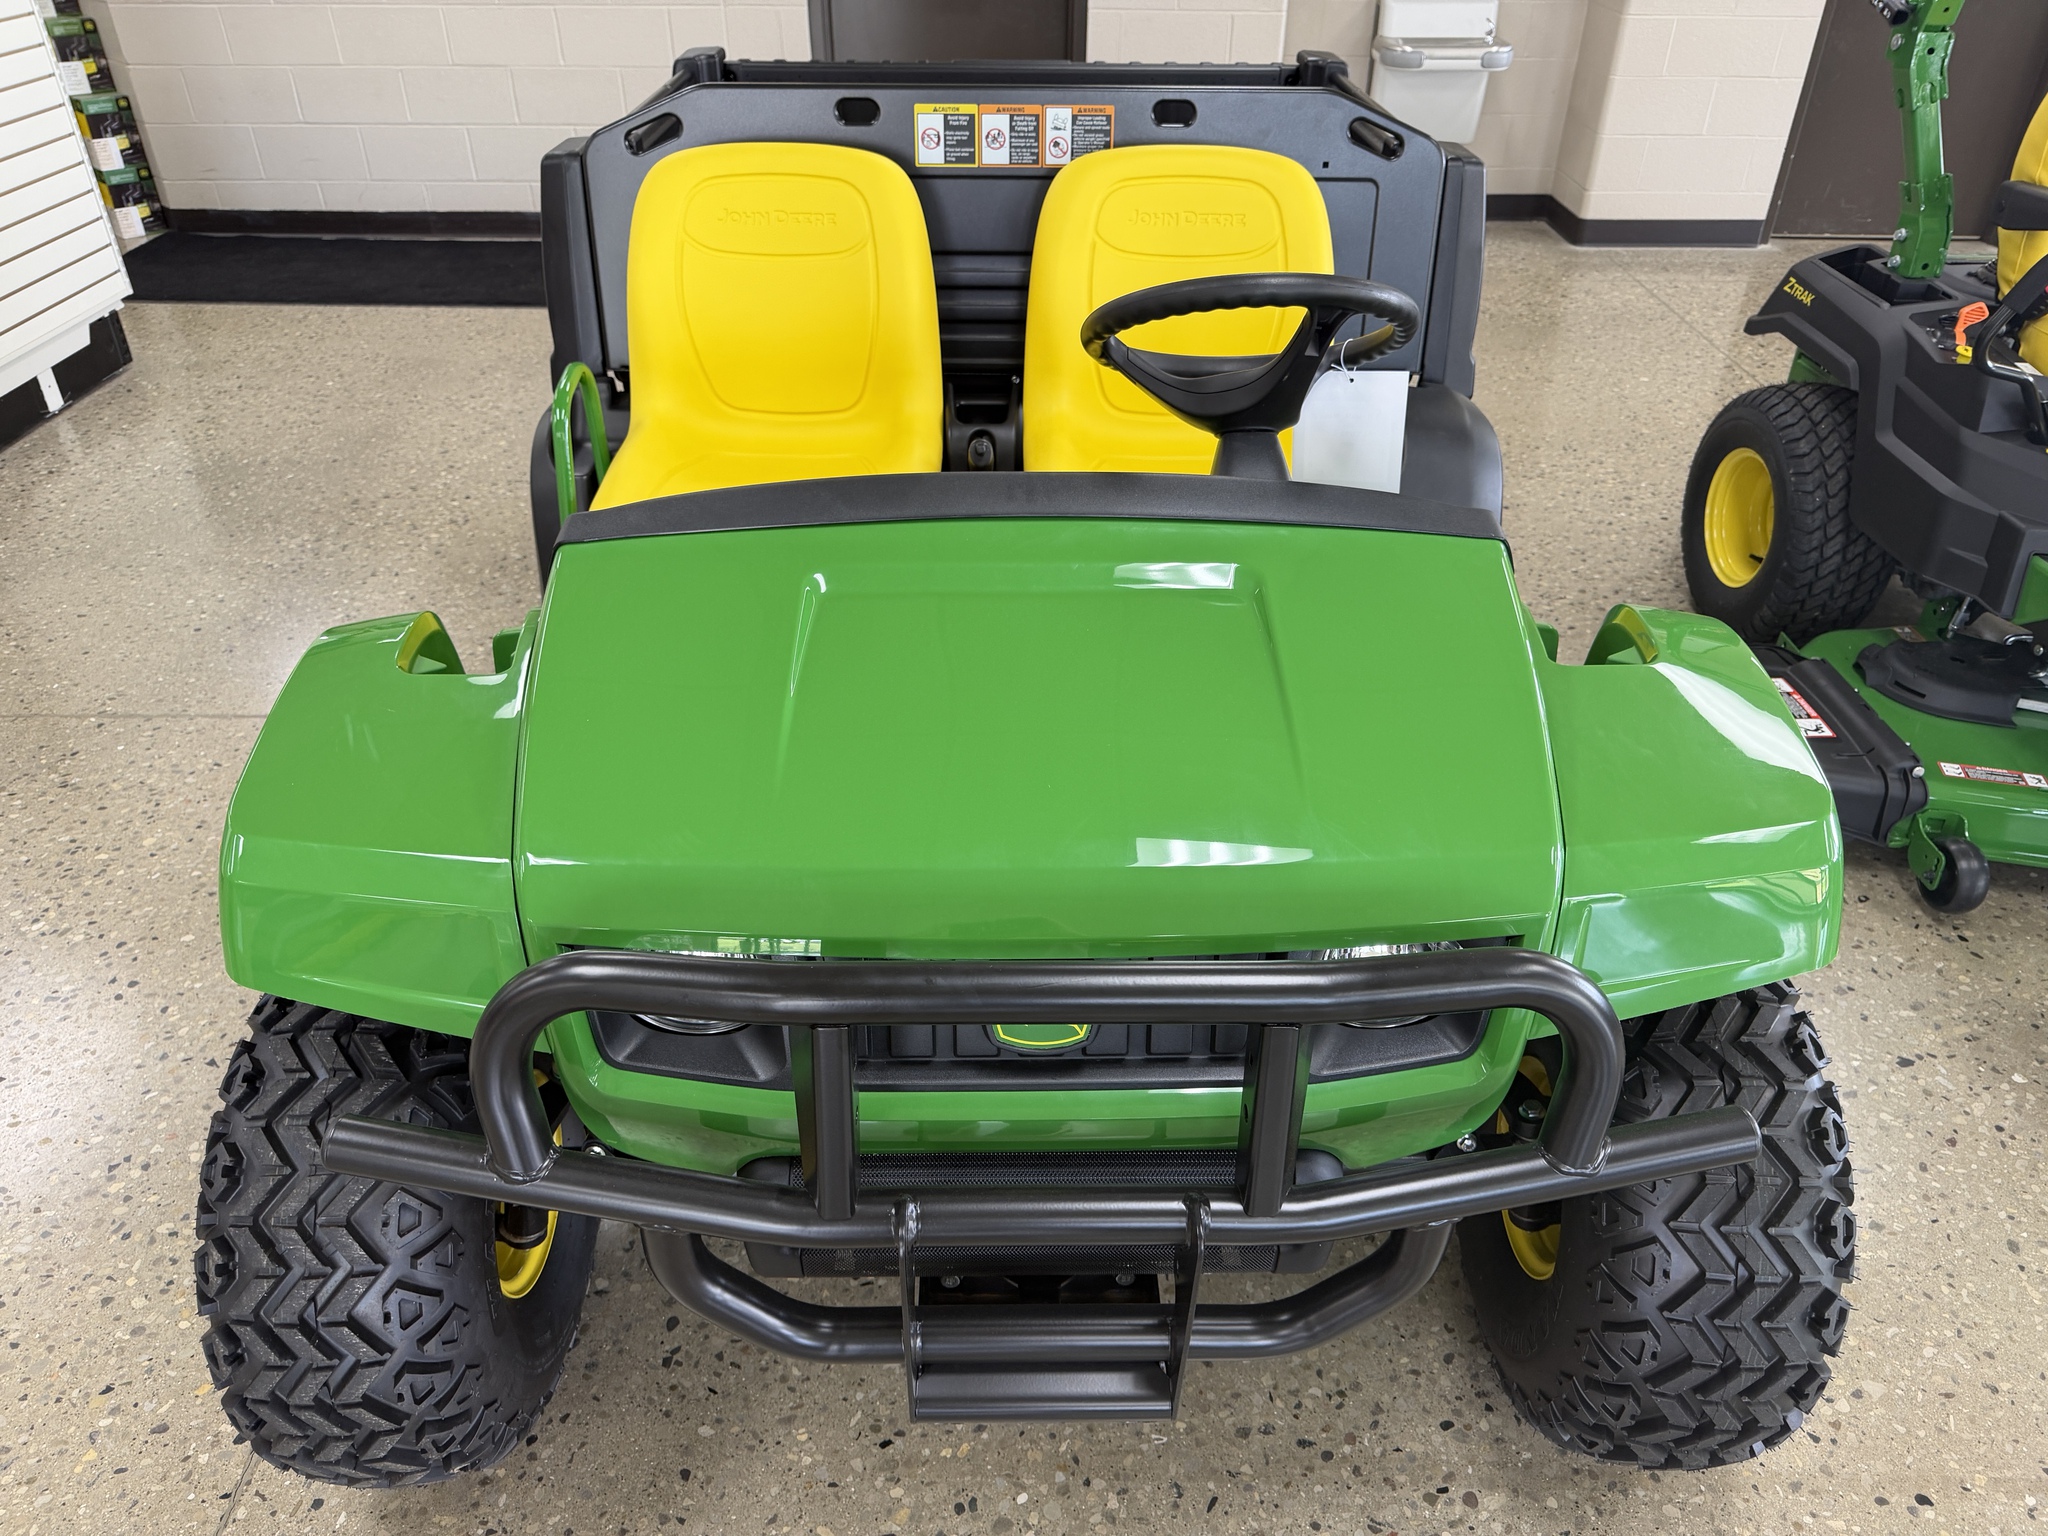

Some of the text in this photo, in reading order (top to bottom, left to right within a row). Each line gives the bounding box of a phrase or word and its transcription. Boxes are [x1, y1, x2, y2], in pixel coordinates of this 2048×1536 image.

[717, 207, 838, 227] JOHN DEERE
[1127, 208, 1247, 228] JOHN DEERE
[1783, 276, 1816, 307] ZTRAK
